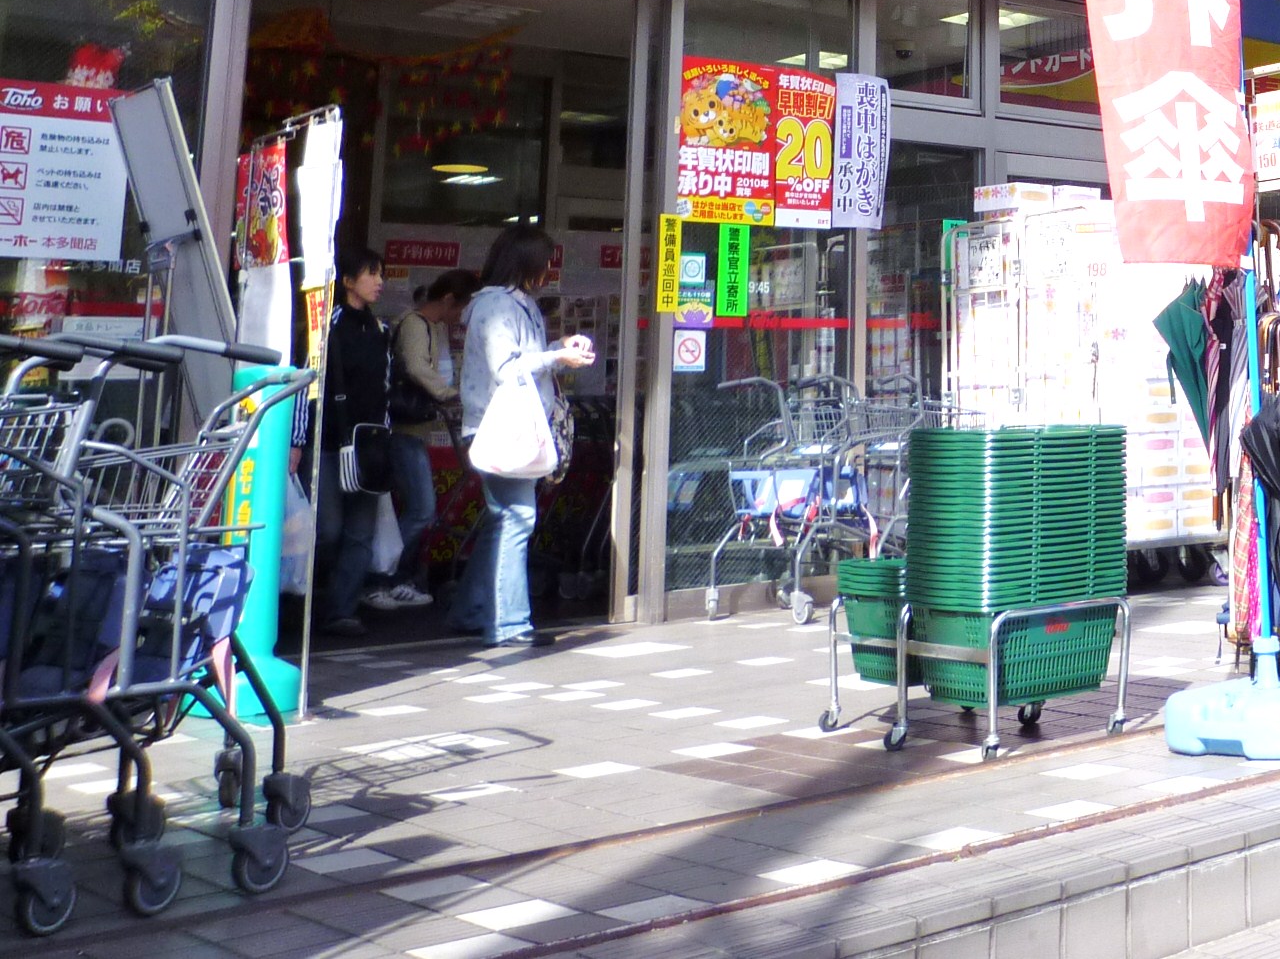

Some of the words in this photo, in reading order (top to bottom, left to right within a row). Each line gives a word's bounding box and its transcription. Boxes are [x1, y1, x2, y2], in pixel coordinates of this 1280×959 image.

[1, 87, 44, 108] Toho
[41, 132, 110, 145] 危険物の持ち込みは
[39, 144, 94, 156] 禁止いたします。
[776, 116, 832, 180] 20
[856, 82, 879, 216] 喪中はがき
[679, 145, 769, 176] 年賀状印刷
[37, 168, 101, 179] ペットの持ち込みは
[678, 170, 732, 197] 承り中
[736, 177, 769, 188] 2010年
[787, 177, 830, 194] %OFF
[838, 162, 852, 213] 承り中
[33, 203, 80, 213] 店内は禁煙と
[693, 201, 743, 211] はがきは当店で
[692, 210, 744, 221] ご用意いたします
[42, 236, 98, 251] 本多聞店
[662, 218, 677, 308] 警備員巡回中
[725, 227, 740, 313] 警察官立寄所
[1087, 263, 1107, 276] 198
